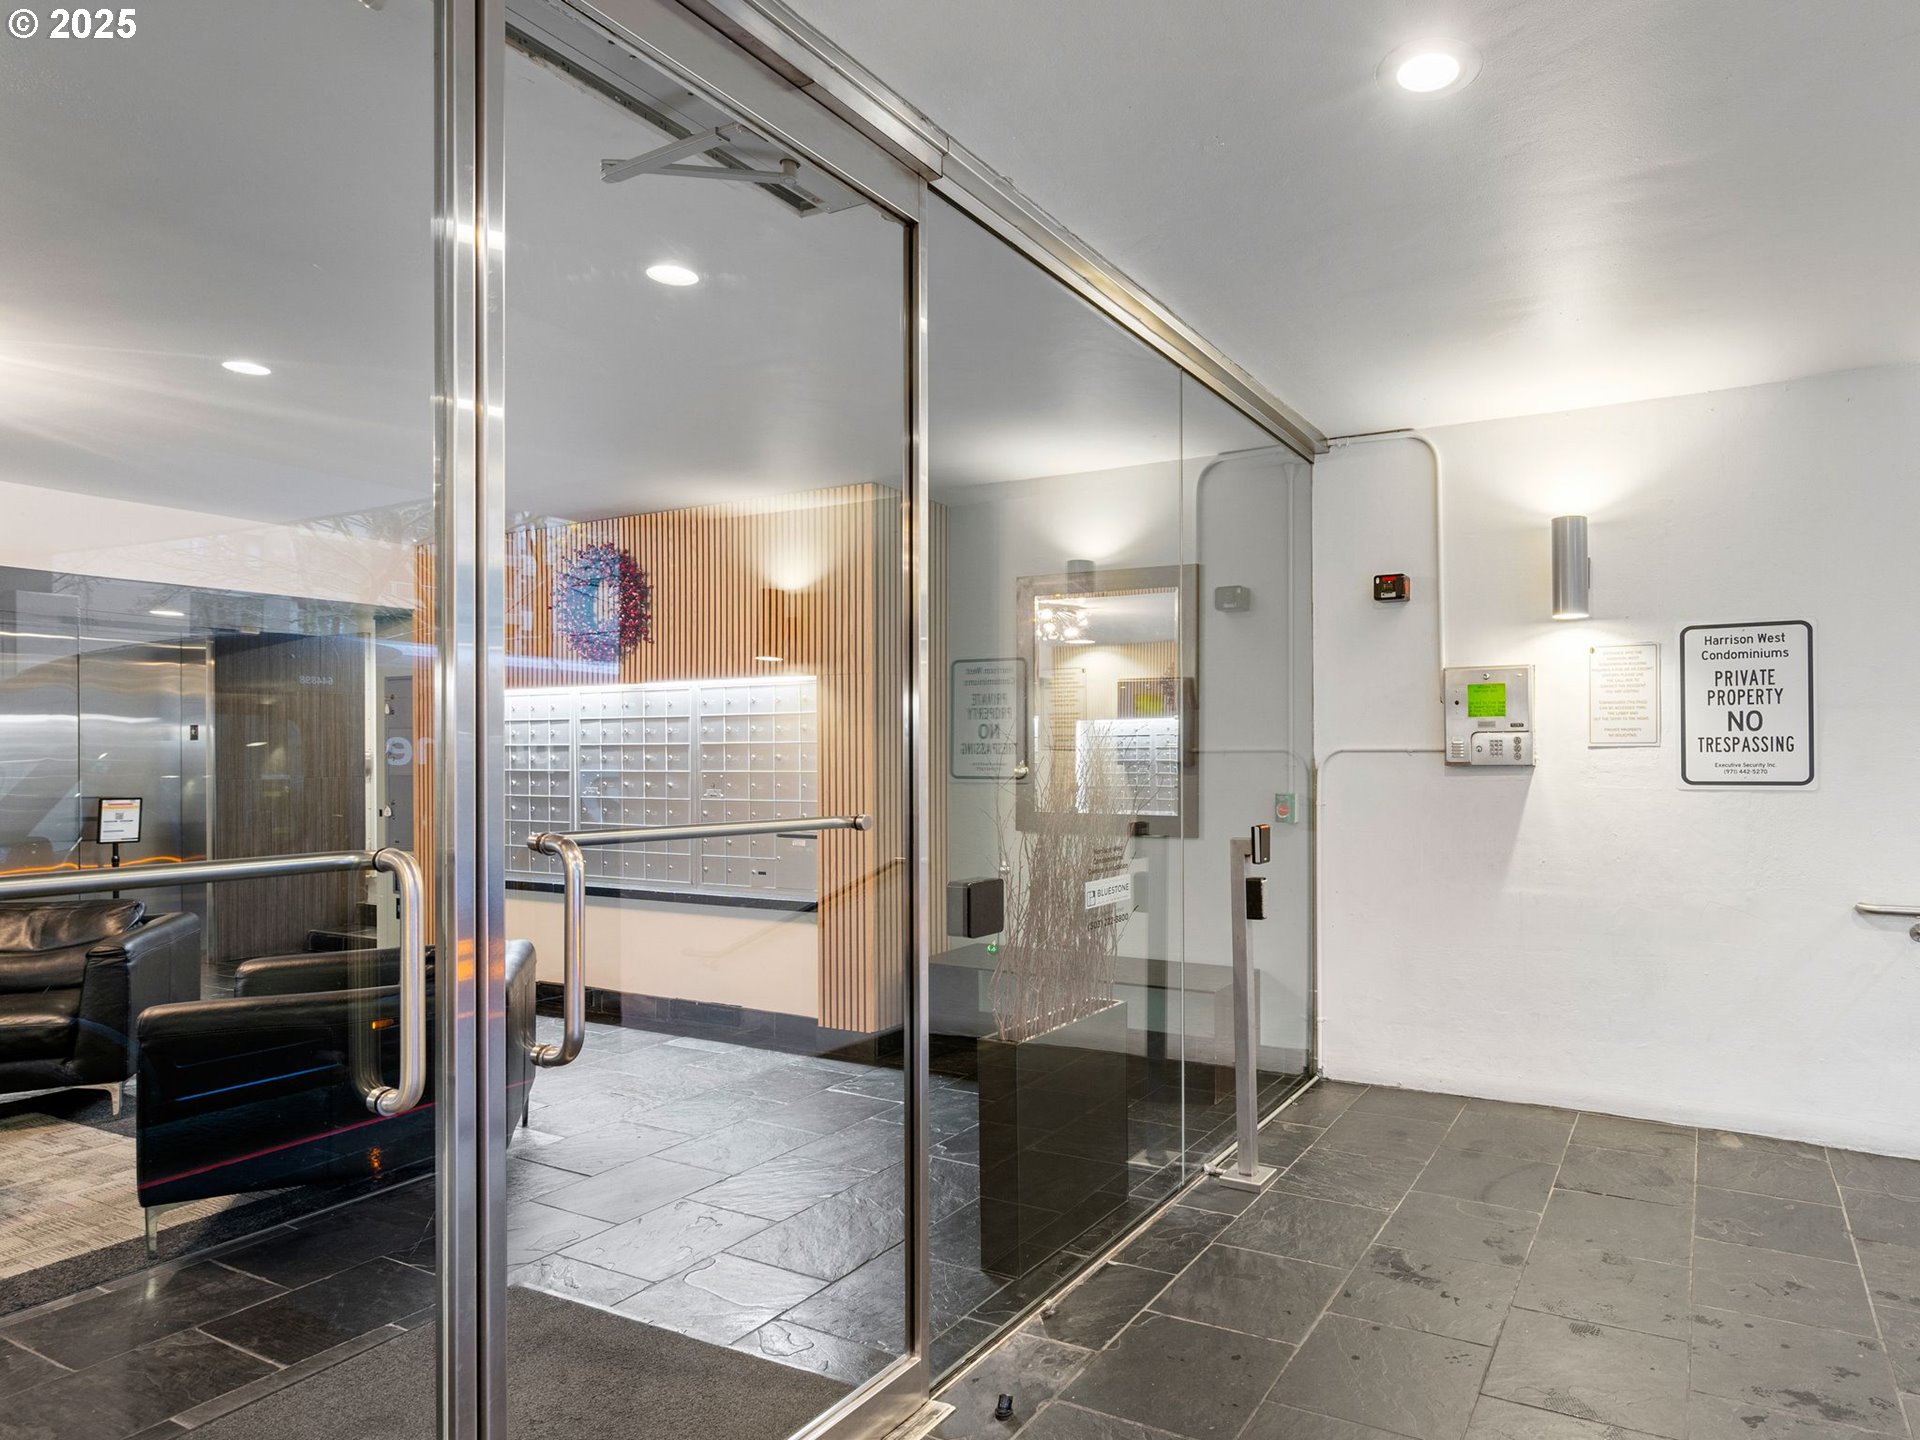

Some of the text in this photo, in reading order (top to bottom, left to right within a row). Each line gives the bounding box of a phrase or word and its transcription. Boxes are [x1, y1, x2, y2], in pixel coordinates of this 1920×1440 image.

[1704, 632, 1786, 646] Harrison West
[1701, 648, 1789, 660] Condominiums
[1714, 669, 1776, 686] PRIVATE
[1707, 688, 1784, 706] PROPERTY
[1727, 710, 1763, 732] NO
[1698, 736, 1795, 752] TRESPASSING
[1097, 883, 1129, 897] BLUESTONE
